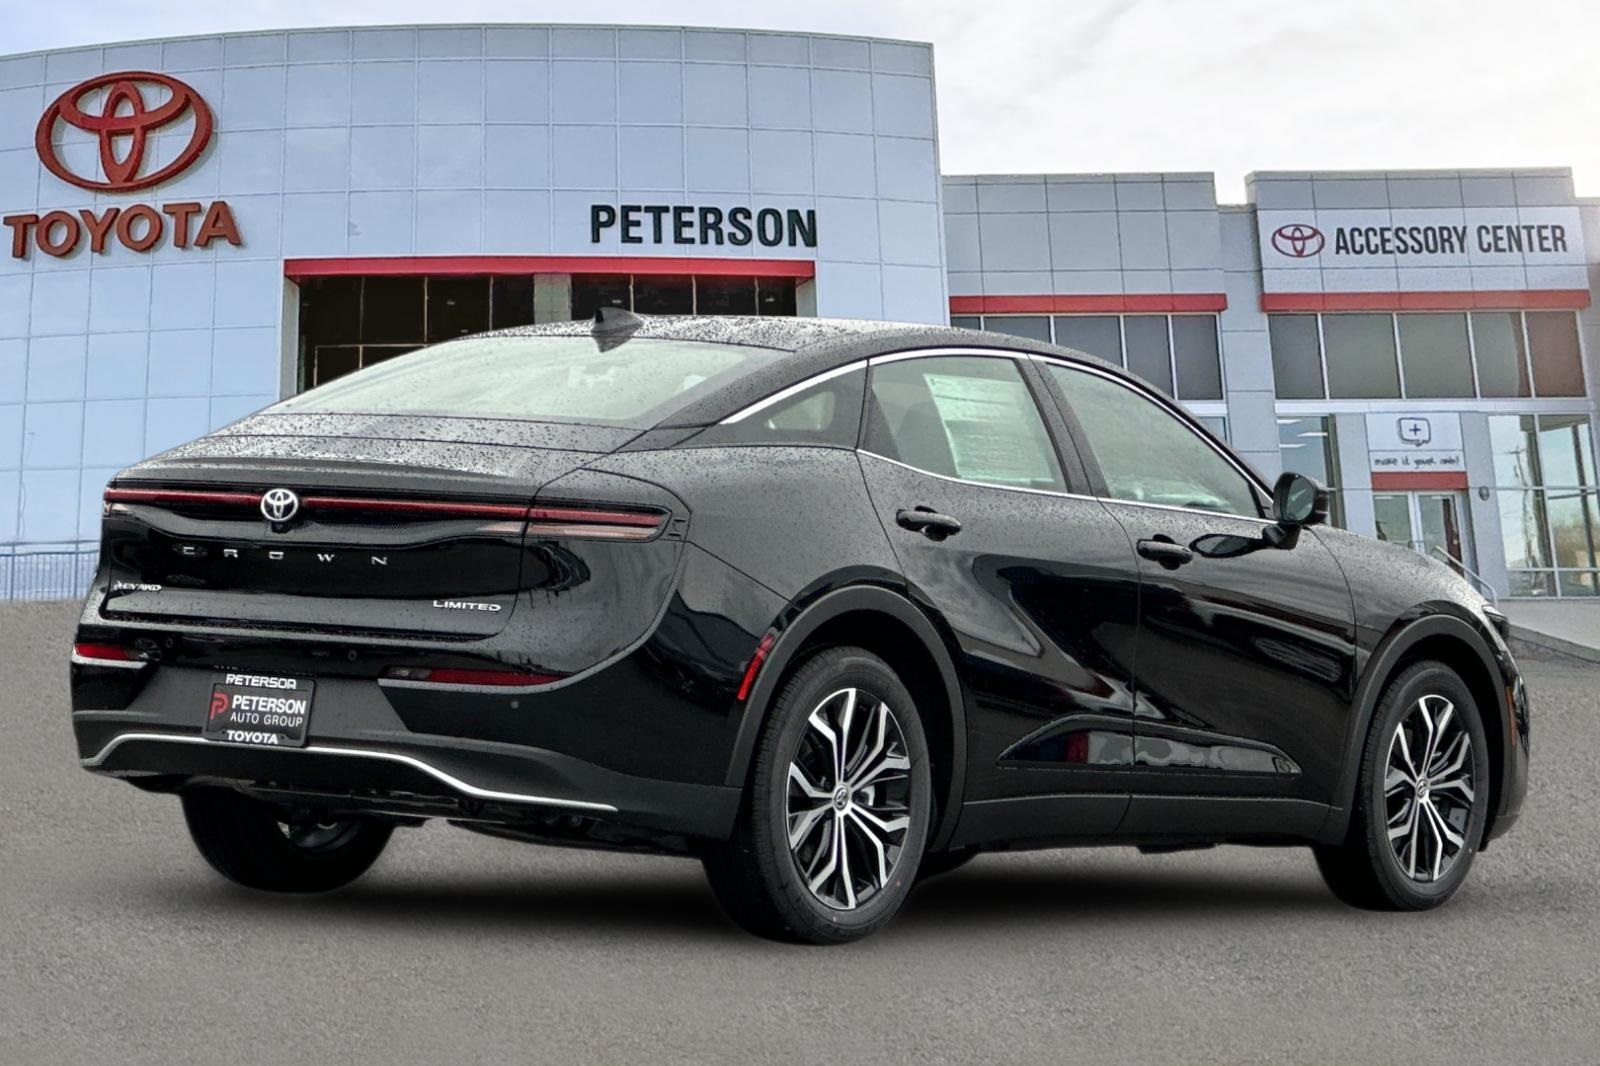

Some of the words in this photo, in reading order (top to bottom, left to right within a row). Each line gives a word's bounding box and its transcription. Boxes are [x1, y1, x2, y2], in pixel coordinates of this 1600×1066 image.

[4, 201, 242, 258] TOYOTA
[591, 204, 818, 248] PETERSON
[1335, 225, 1468, 255] ACCESSORY
[1477, 224, 1568, 253] CENTER
[182, 545, 388, 566] CROWN
[433, 600, 502, 611] LIMITED
[231, 695, 306, 715] PETERSON
[230, 711, 260, 725] AUTO
[263, 714, 303, 732] GROUP
[226, 730, 279, 745] TOYOTA
